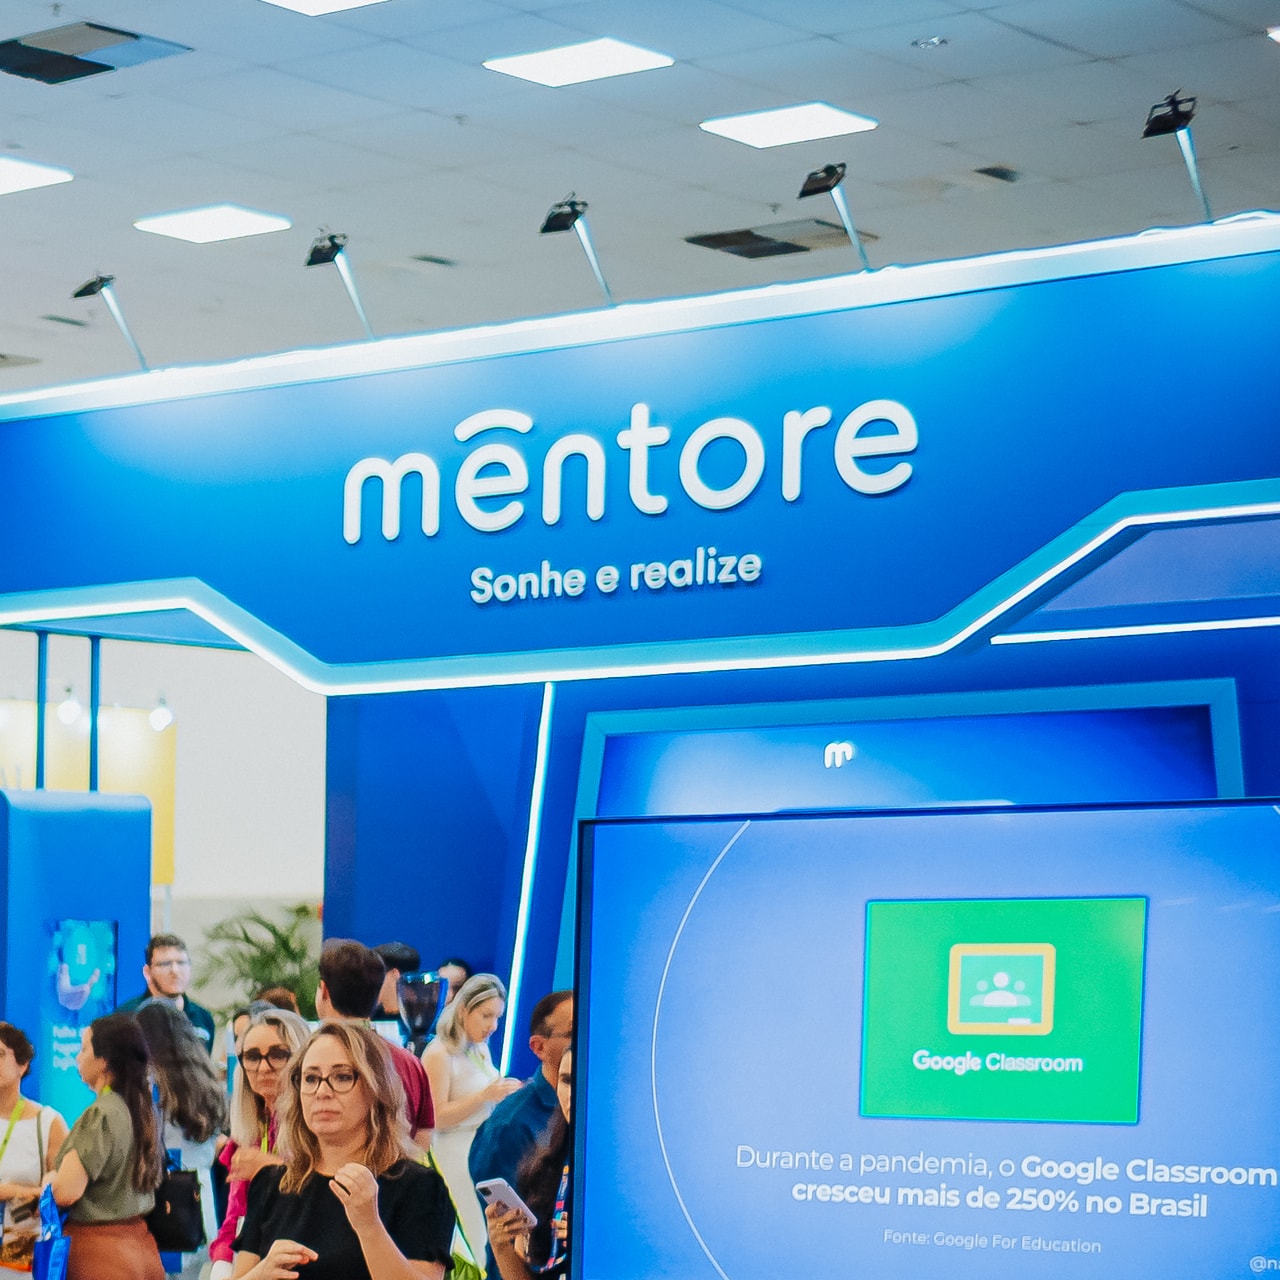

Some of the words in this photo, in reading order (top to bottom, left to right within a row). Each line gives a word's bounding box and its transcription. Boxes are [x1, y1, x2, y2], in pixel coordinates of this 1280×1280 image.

[470, 560, 586, 604] Sonhe
[595, 565, 620, 593] e
[630, 546, 762, 591] realize
[912, 1049, 982, 1076] Google
[985, 1051, 1083, 1073] Classroom
[736, 1145, 834, 1170] Durante
[839, 1154, 853, 1170] a
[860, 1150, 993, 1178] pandemia,
[998, 1159, 1015, 1177] o
[1021, 1155, 1119, 1186] Google
[1125, 1158, 1278, 1187] Classroom
[792, 1182, 890, 1205] cresceu
[897, 1185, 960, 1208] mais
[966, 1187, 1000, 1210] de
[1006, 1189, 1079, 1213] 250%
[1086, 1197, 1122, 1214] no
[1130, 1193, 1207, 1218] Brasil
[884, 1229, 930, 1246] Fonte:
[933, 1231, 988, 1251] Google
[992, 1234, 1018, 1249] For
[1021, 1236, 1102, 1254] Education
[1250, 1255, 1280, 1273] @n
